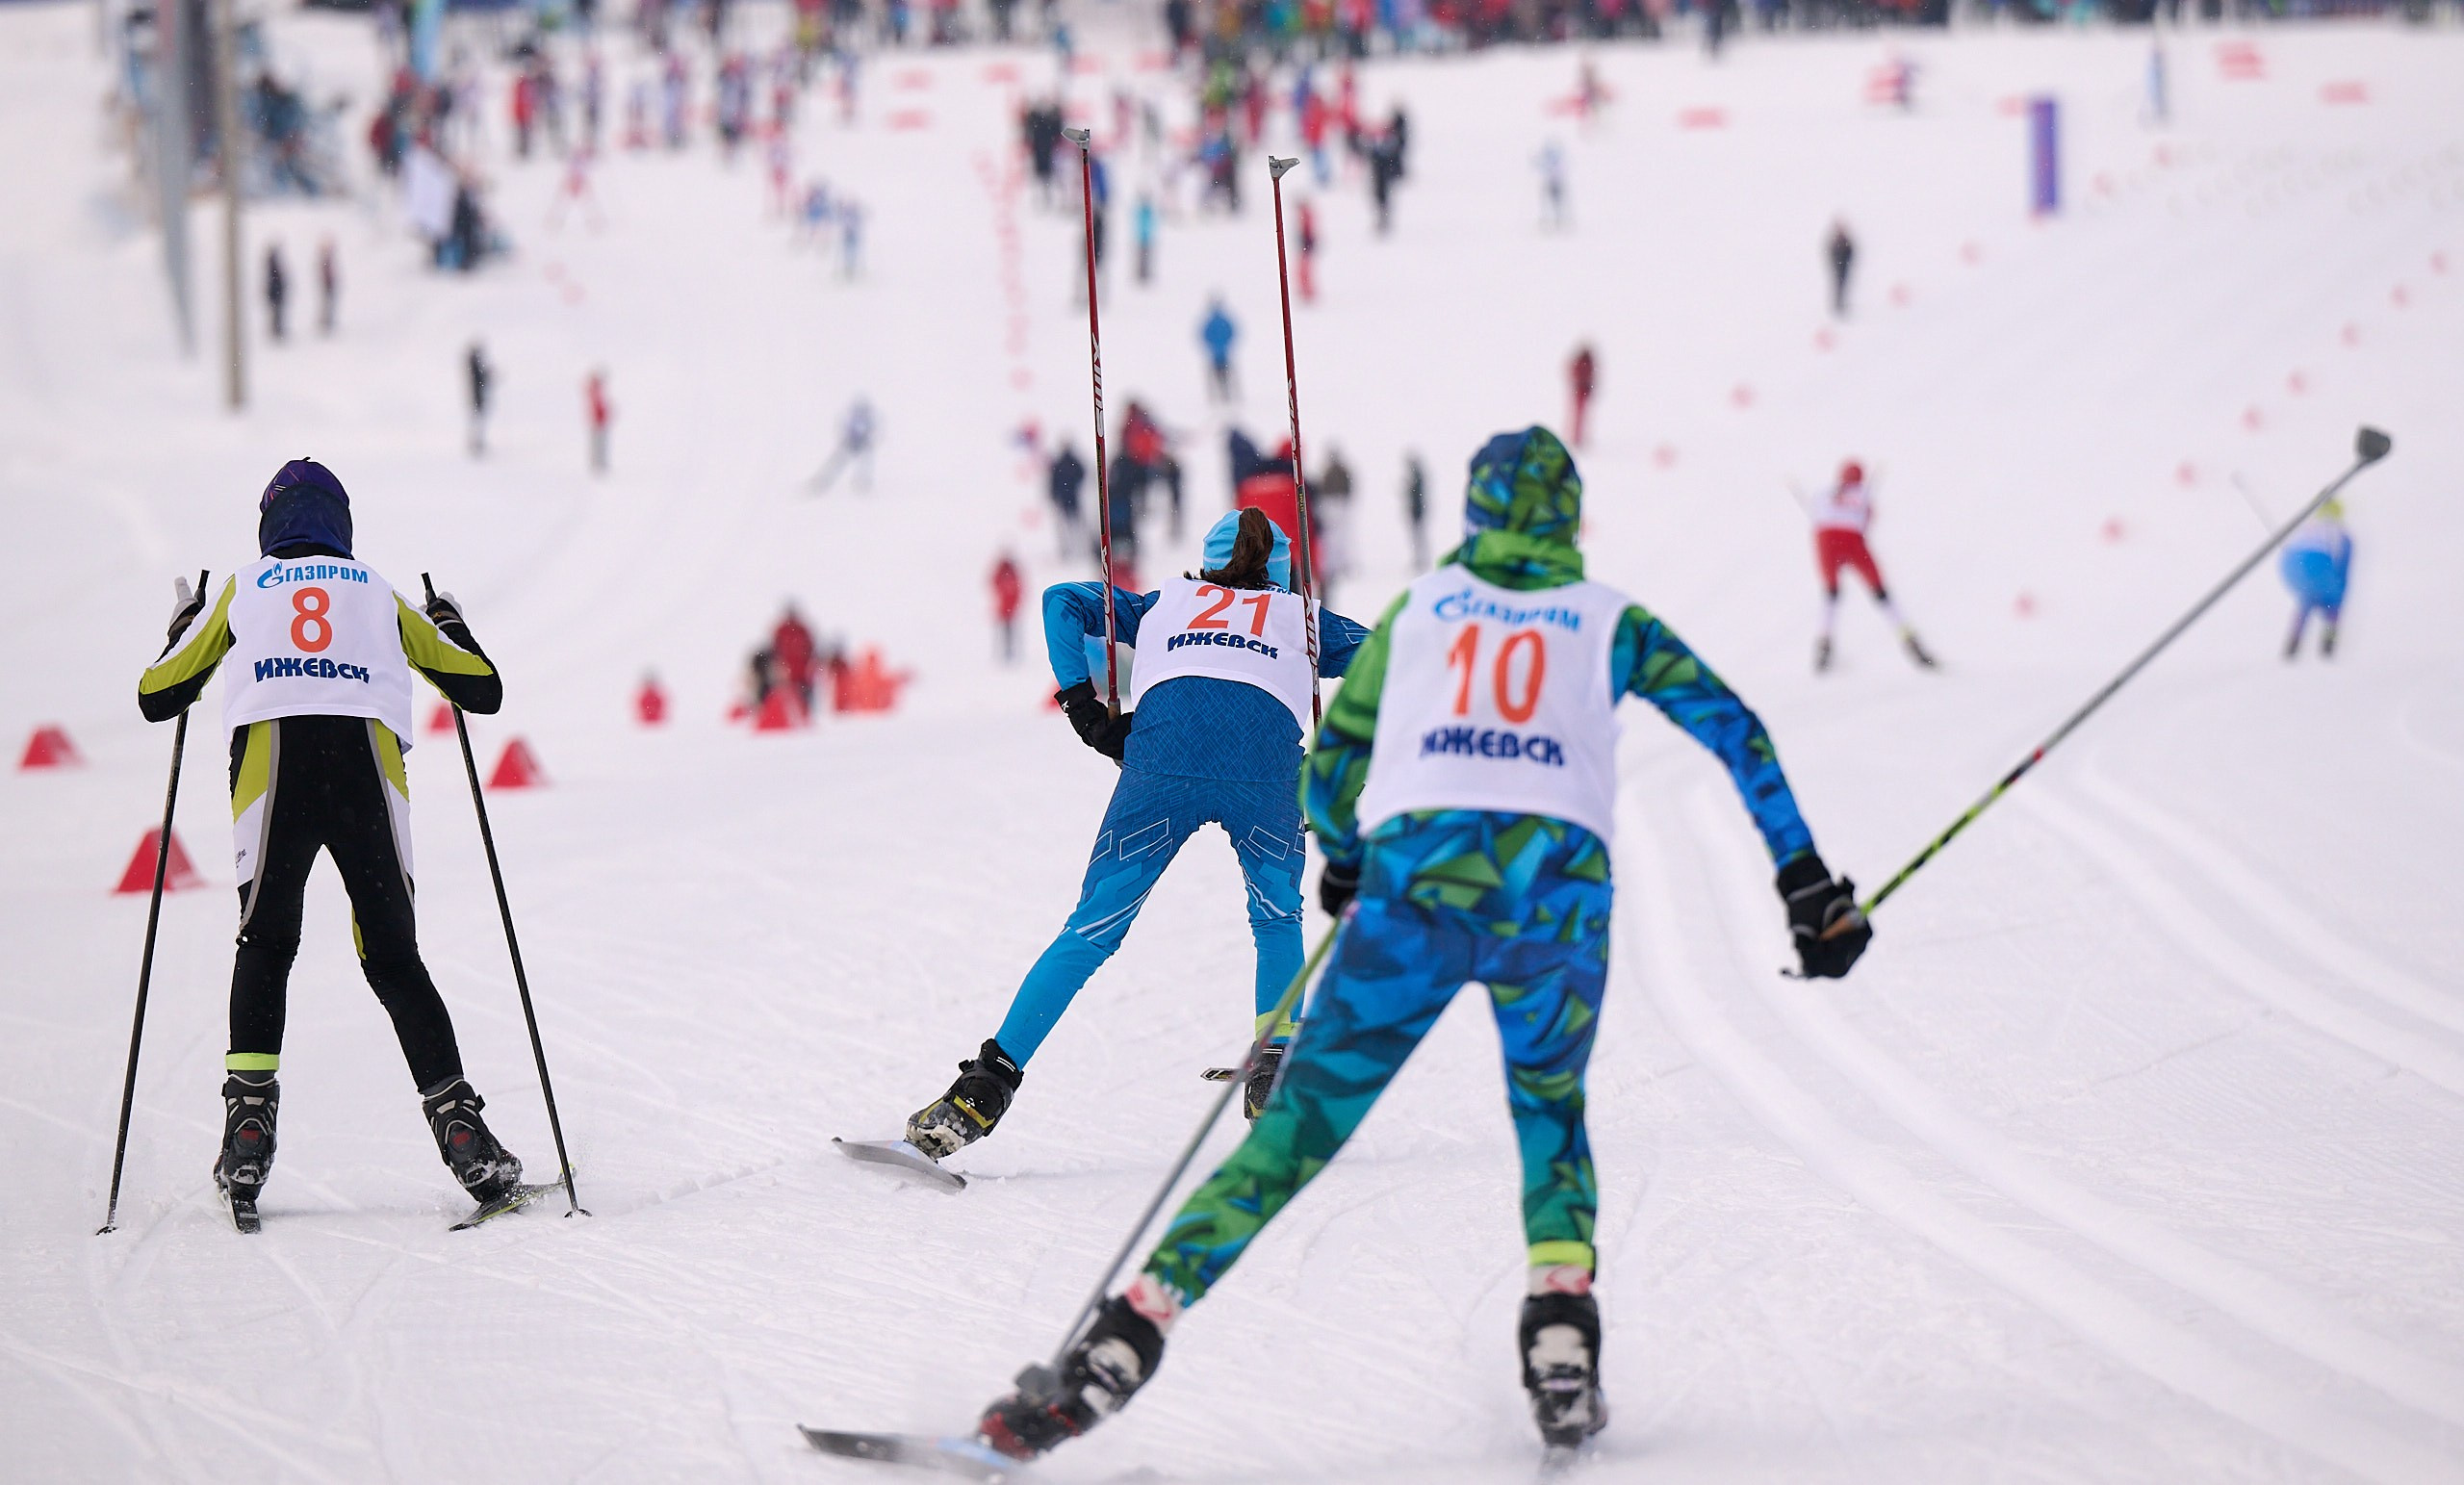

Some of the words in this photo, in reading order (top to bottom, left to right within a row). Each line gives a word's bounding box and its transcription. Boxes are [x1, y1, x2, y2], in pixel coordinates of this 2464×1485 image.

[285, 565, 369, 584] ГАЗПРОМ
[291, 587, 333, 653] 8
[1186, 584, 1272, 638] 21
[1168, 632, 1279, 660] ИЖЕВСК
[254, 657, 370, 684] ИЖЕВСК
[1448, 623, 1546, 726] 10
[1420, 726, 1565, 767] ИЖЕВСК
